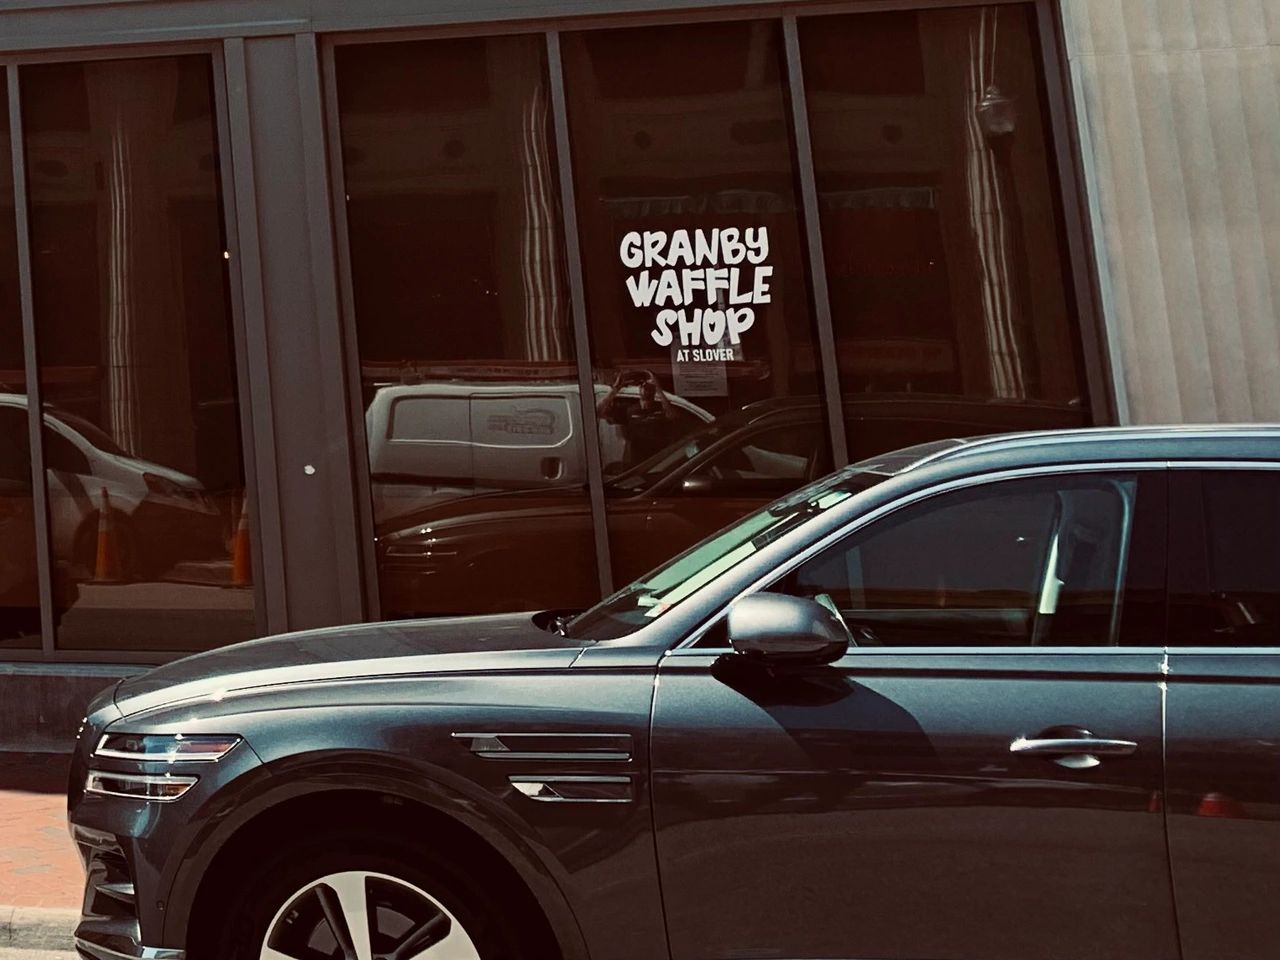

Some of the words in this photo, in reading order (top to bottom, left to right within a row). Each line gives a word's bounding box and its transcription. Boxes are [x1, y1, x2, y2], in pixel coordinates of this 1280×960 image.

[620, 226, 769, 268] GRANBY
[625, 266, 774, 308] WAFFLE
[650, 307, 755, 347] SHOP
[676, 349, 690, 362] AT
[692, 348, 734, 362] SLOVER
